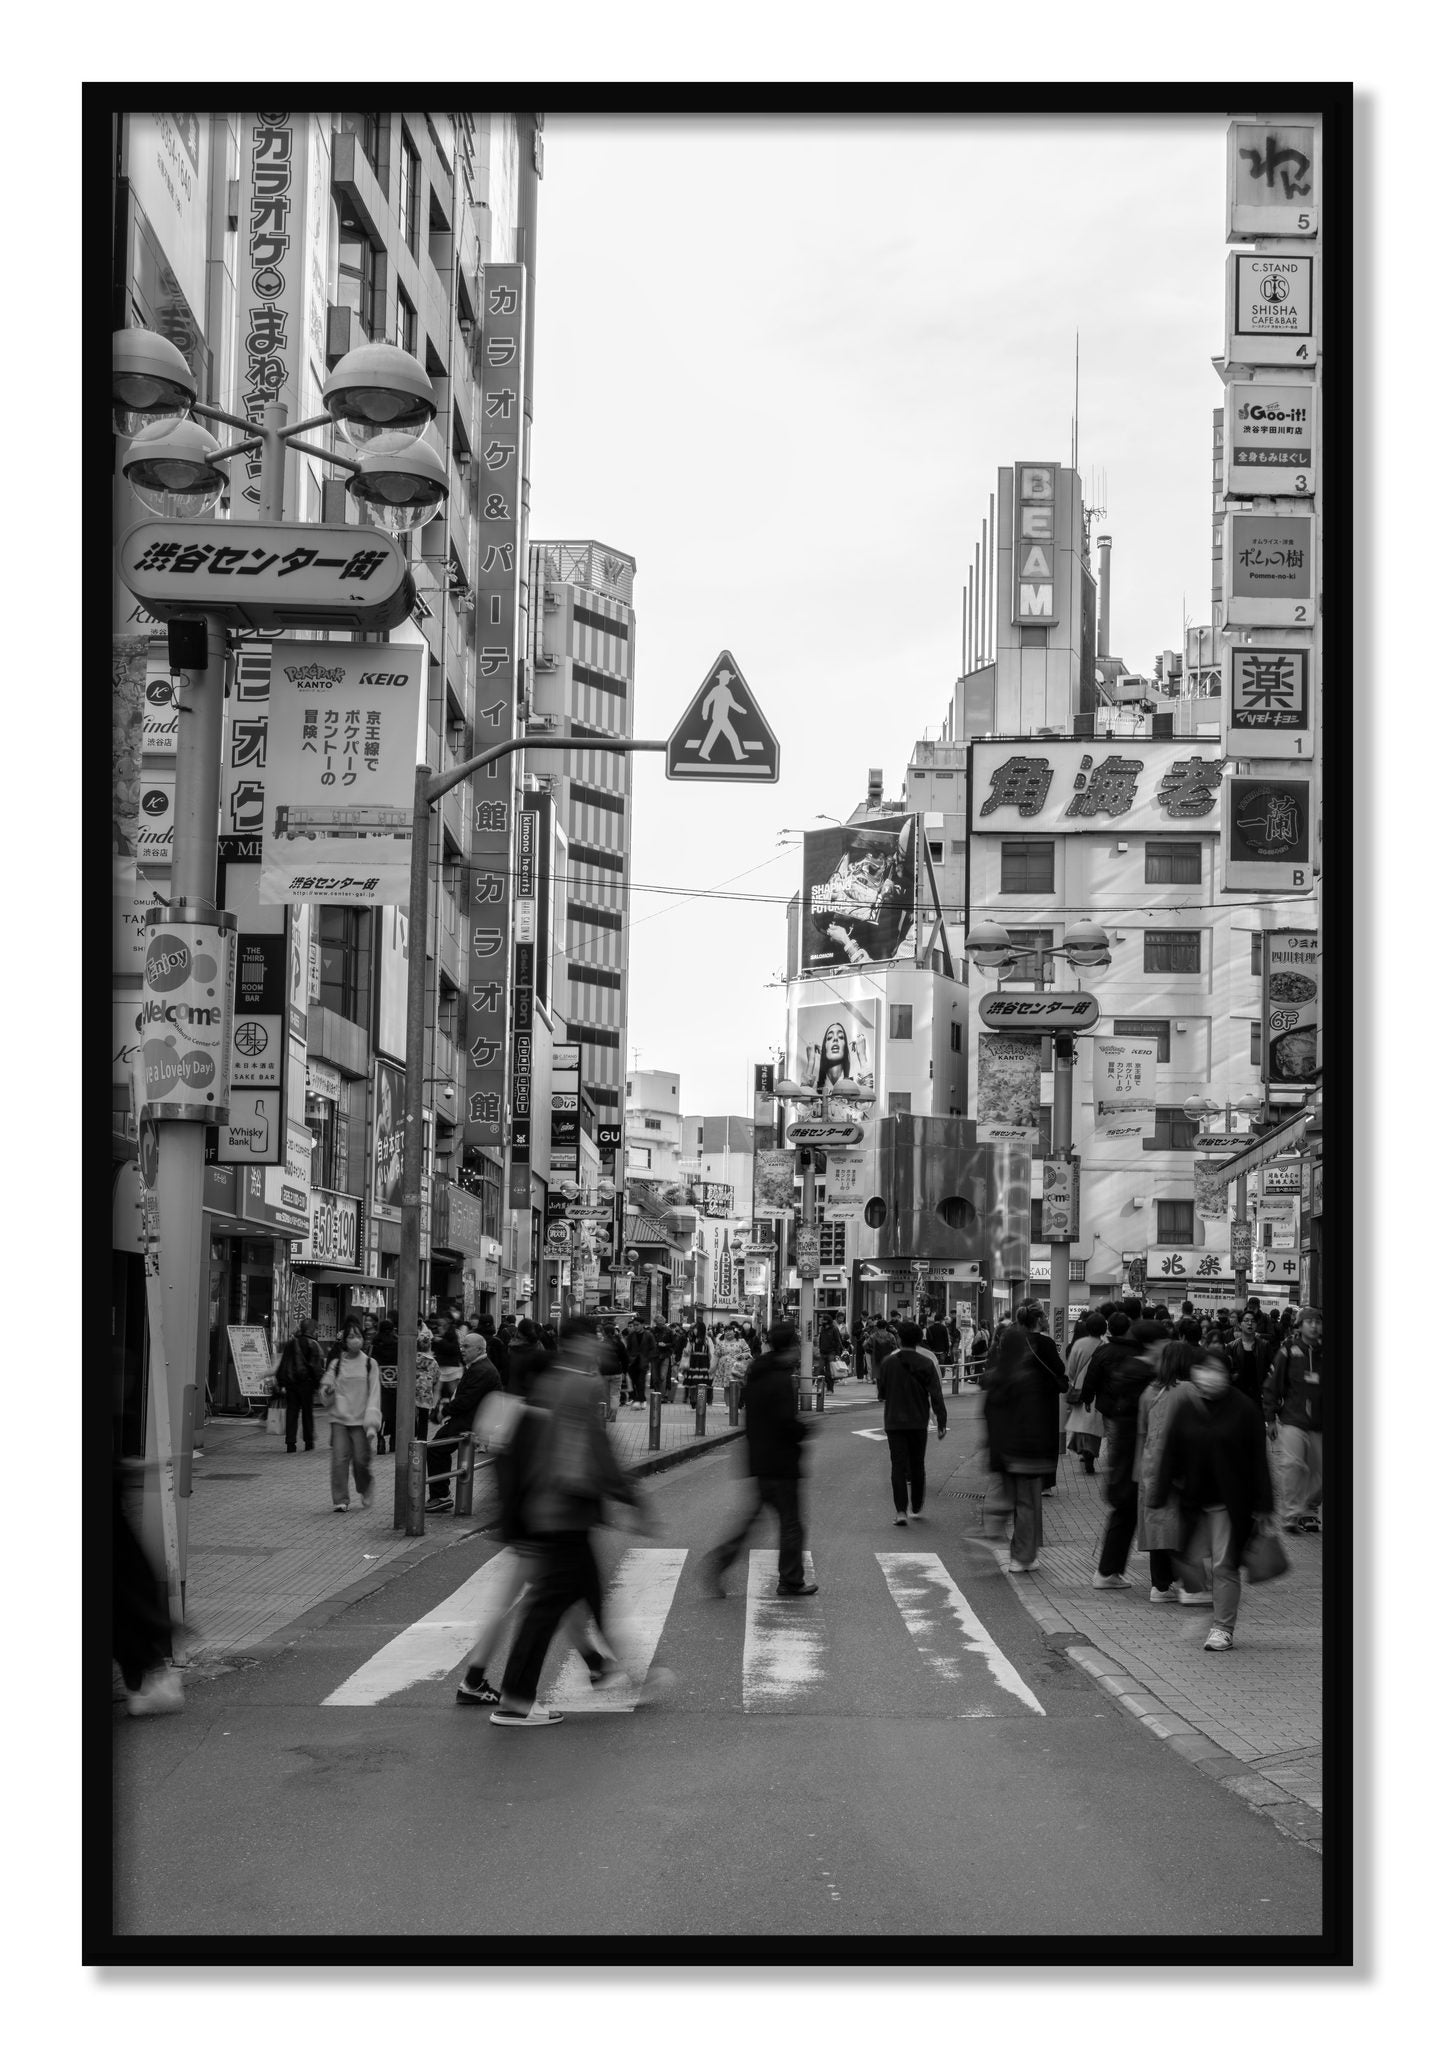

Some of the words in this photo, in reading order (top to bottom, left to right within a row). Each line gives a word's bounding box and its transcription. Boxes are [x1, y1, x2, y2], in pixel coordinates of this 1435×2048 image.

[250, 126, 293, 269] カラオケ
[1297, 214, 1310, 230] 5
[1251, 262, 1298, 273] C.STAND
[1251, 304, 1298, 316] SHISHA
[1251, 316, 1298, 325] CAFE&BAR
[1296, 344, 1309, 360] 4
[1250, 405, 1306, 421] Goo-it!
[1243, 425, 1302, 435] 渋谷宇田川町店
[1238, 451, 1308, 463] 全身もみほぐし
[1295, 475, 1307, 491] 3
[1020, 467, 1054, 616] BEAM
[133, 542, 389, 581] 渋谷センター街
[1239, 547, 1305, 568] ポムの樹
[1249, 572, 1296, 580] Pomme-no-ki
[1294, 605, 1306, 622] 2
[297, 681, 333, 689] KANTO
[359, 672, 409, 687] KEIO
[1242, 655, 1294, 708] 薬
[301, 709, 318, 754] 冒険へ
[147, 738, 172, 747] 渋谷店
[320, 709, 339, 786] カントーの
[341, 709, 360, 786] ポケパーク
[364, 710, 381, 772] 京王線で
[1294, 737, 1302, 754] 1
[979, 754, 1223, 817] 角海老
[1236, 795, 1299, 845] 一蘭
[522, 816, 532, 853] kimono
[143, 847, 168, 857] 渋谷店
[289, 876, 380, 890] 渋谷センター街
[521, 858, 531, 893] hearts
[1293, 869, 1305, 886] B
[242, 954, 265, 962] THIRD
[246, 947, 261, 955] THE
[810, 952, 834, 960] SALOMON
[1271, 951, 1317, 964] 四川料理
[146, 948, 188, 984] Enjoy
[241, 983, 264, 991] ROOM
[245, 994, 260, 1002] BAR
[143, 1000, 221, 1026] Welcome
[986, 1001, 1092, 1015] 渋谷センター街
[1269, 1010, 1299, 1031] 6F
[160, 1059, 192, 1080] Lovely
[193, 1061, 213, 1074] Day!
[234, 1073, 255, 1081] SAKE
[259, 1073, 276, 1081] BAR
[229, 1127, 264, 1139] Whisky
[599, 1130, 620, 1142] GU
[790, 1127, 854, 1137] 渋谷センター街
[228, 1137, 250, 1146] Bank
[1197, 1138, 1255, 1146] 渋谷センター街
[1161, 1253, 1222, 1276] 兆楽
[721, 1252, 730, 1295] BEER
